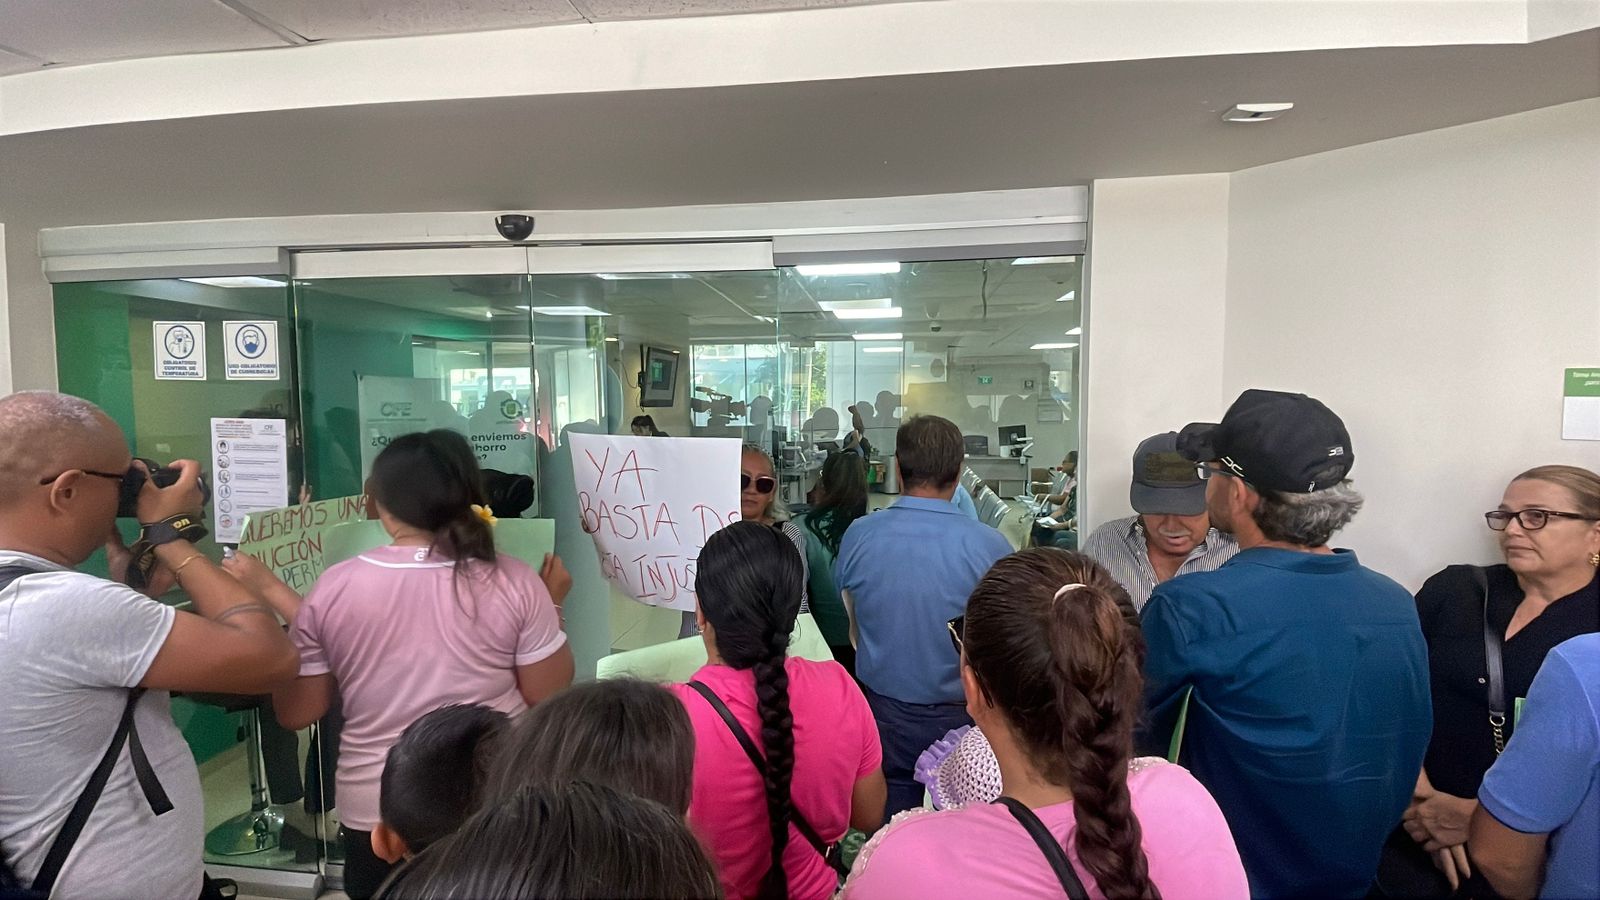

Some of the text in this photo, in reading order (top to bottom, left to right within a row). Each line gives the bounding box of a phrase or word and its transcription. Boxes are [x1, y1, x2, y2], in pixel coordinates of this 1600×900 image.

[471, 432, 527, 442] enviemos
[585, 447, 658, 501] YA
[579, 491, 680, 545] BASTA
